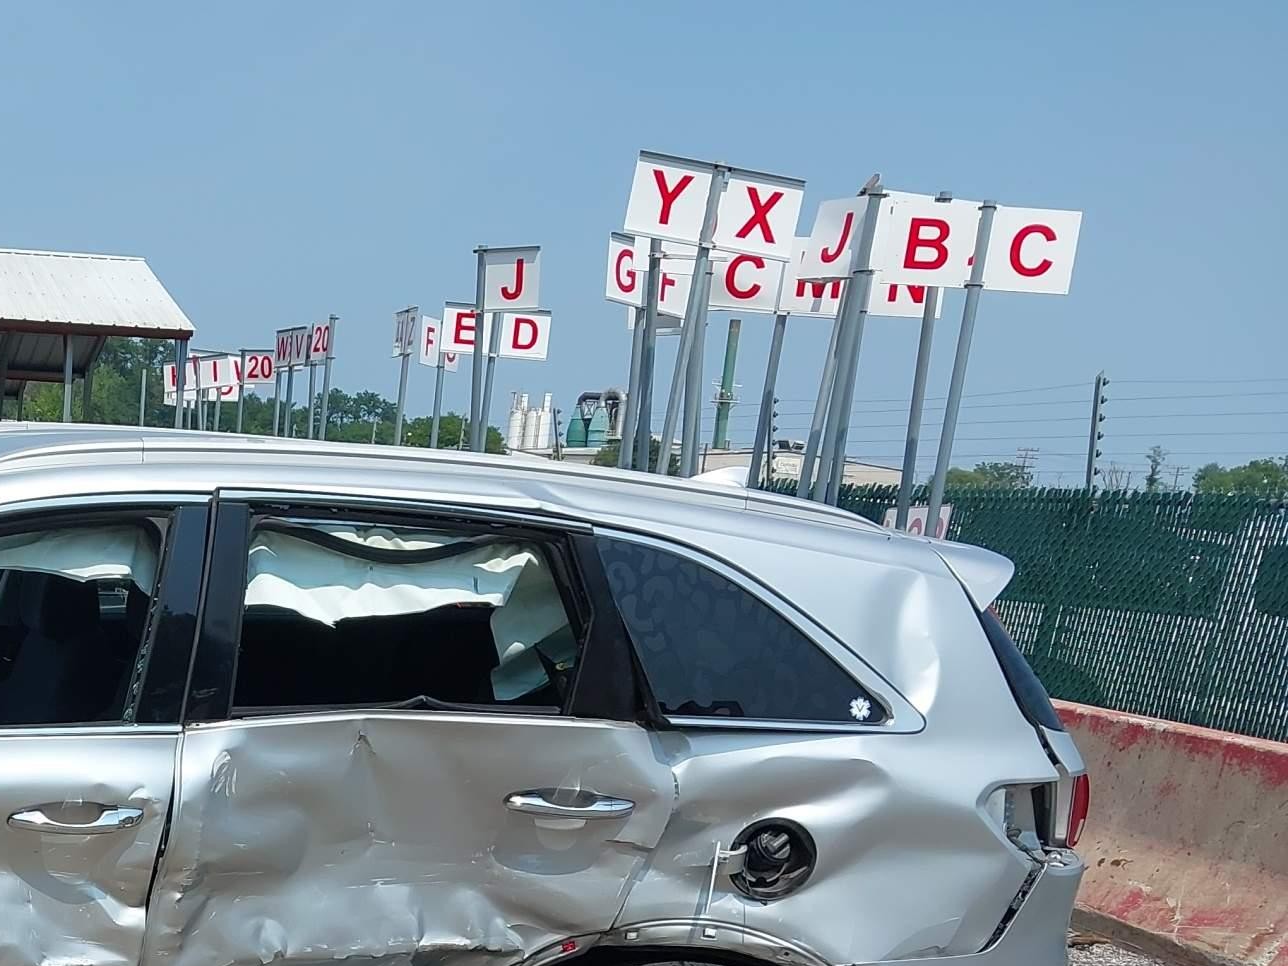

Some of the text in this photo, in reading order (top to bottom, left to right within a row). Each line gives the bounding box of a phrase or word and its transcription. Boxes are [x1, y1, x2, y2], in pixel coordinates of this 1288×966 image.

[653, 169, 695, 225] Y
[735, 186, 784, 244] X
[821, 211, 854, 263] J
[903, 217, 950, 270] B
[1010, 224, 1057, 277] C
[501, 258, 524, 300] J
[615, 249, 636, 293] G
[725, 254, 765, 299] C
[296, 333, 305, 359] V
[312, 325, 329, 353] 20
[425, 326, 435, 356] F
[512, 317, 538, 350] D
[247, 355, 272, 379] 20
